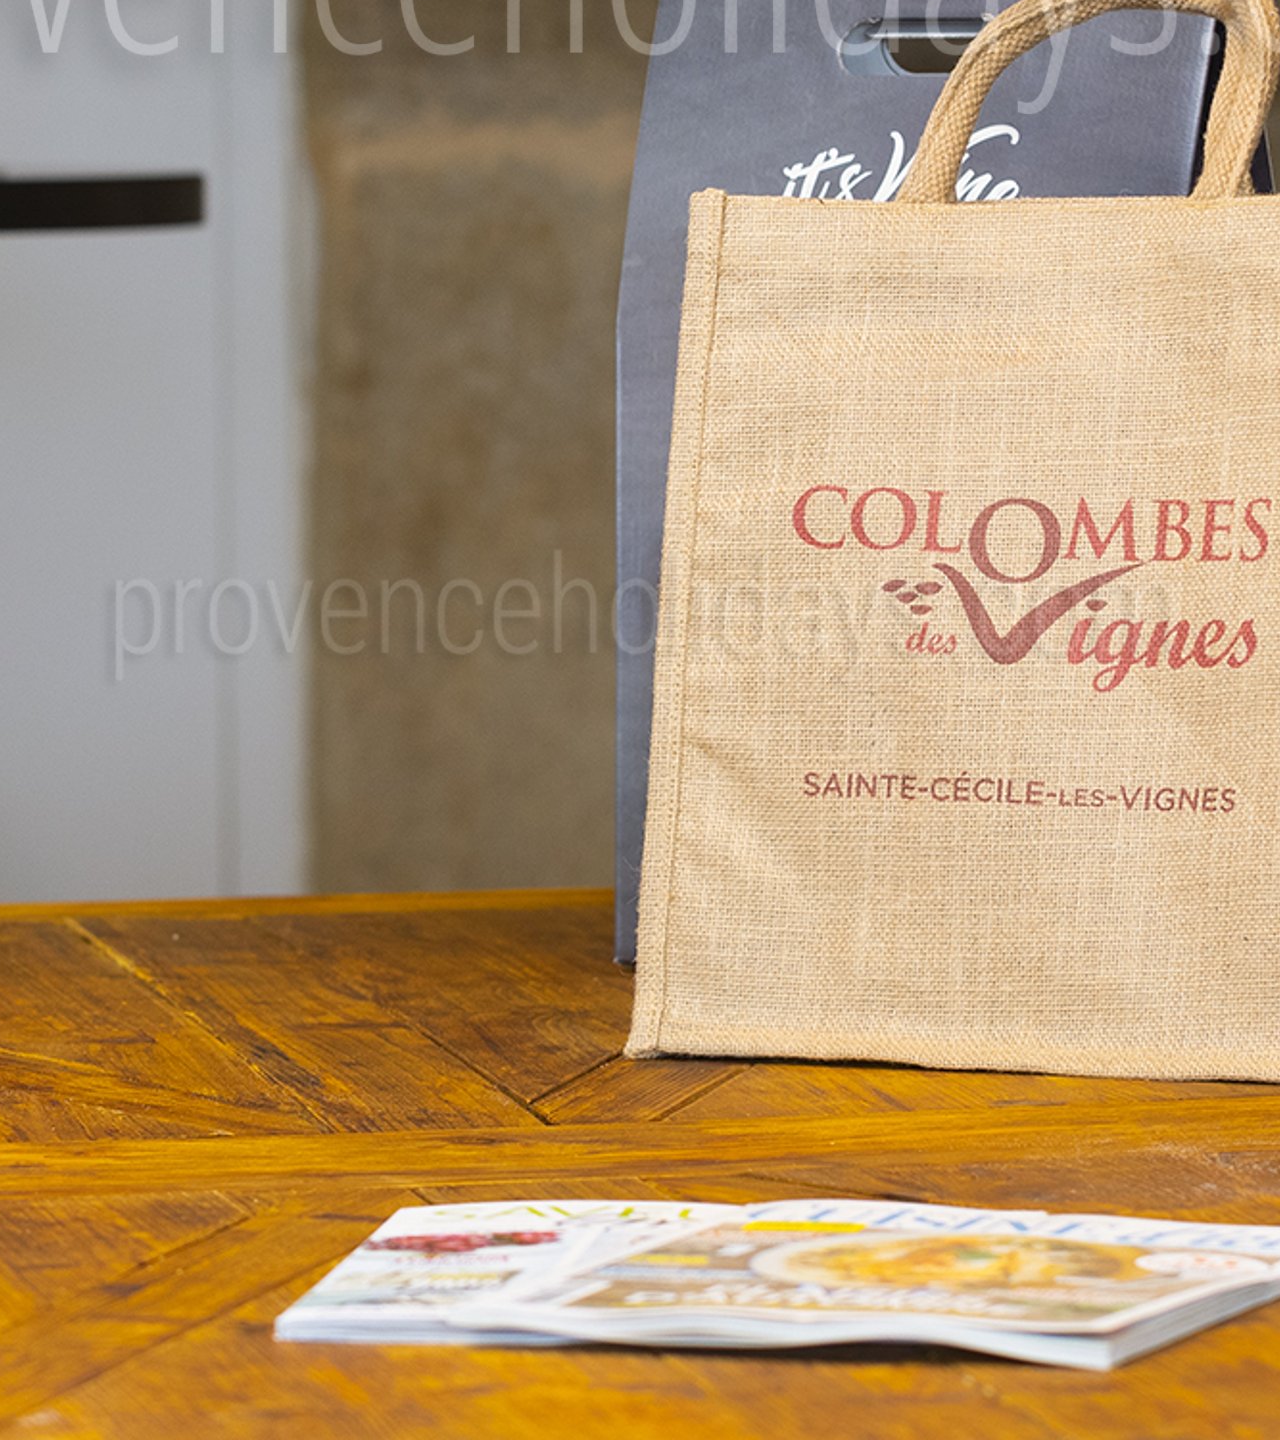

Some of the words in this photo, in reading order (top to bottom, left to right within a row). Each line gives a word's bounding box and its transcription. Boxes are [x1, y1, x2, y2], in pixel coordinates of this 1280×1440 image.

[791, 484, 1273, 584] COLOMBES
[905, 621, 958, 655] des
[932, 561, 1259, 693] Vignes
[802, 770, 1238, 813] SAINTE-CÉCILE-LES-VIGNES
